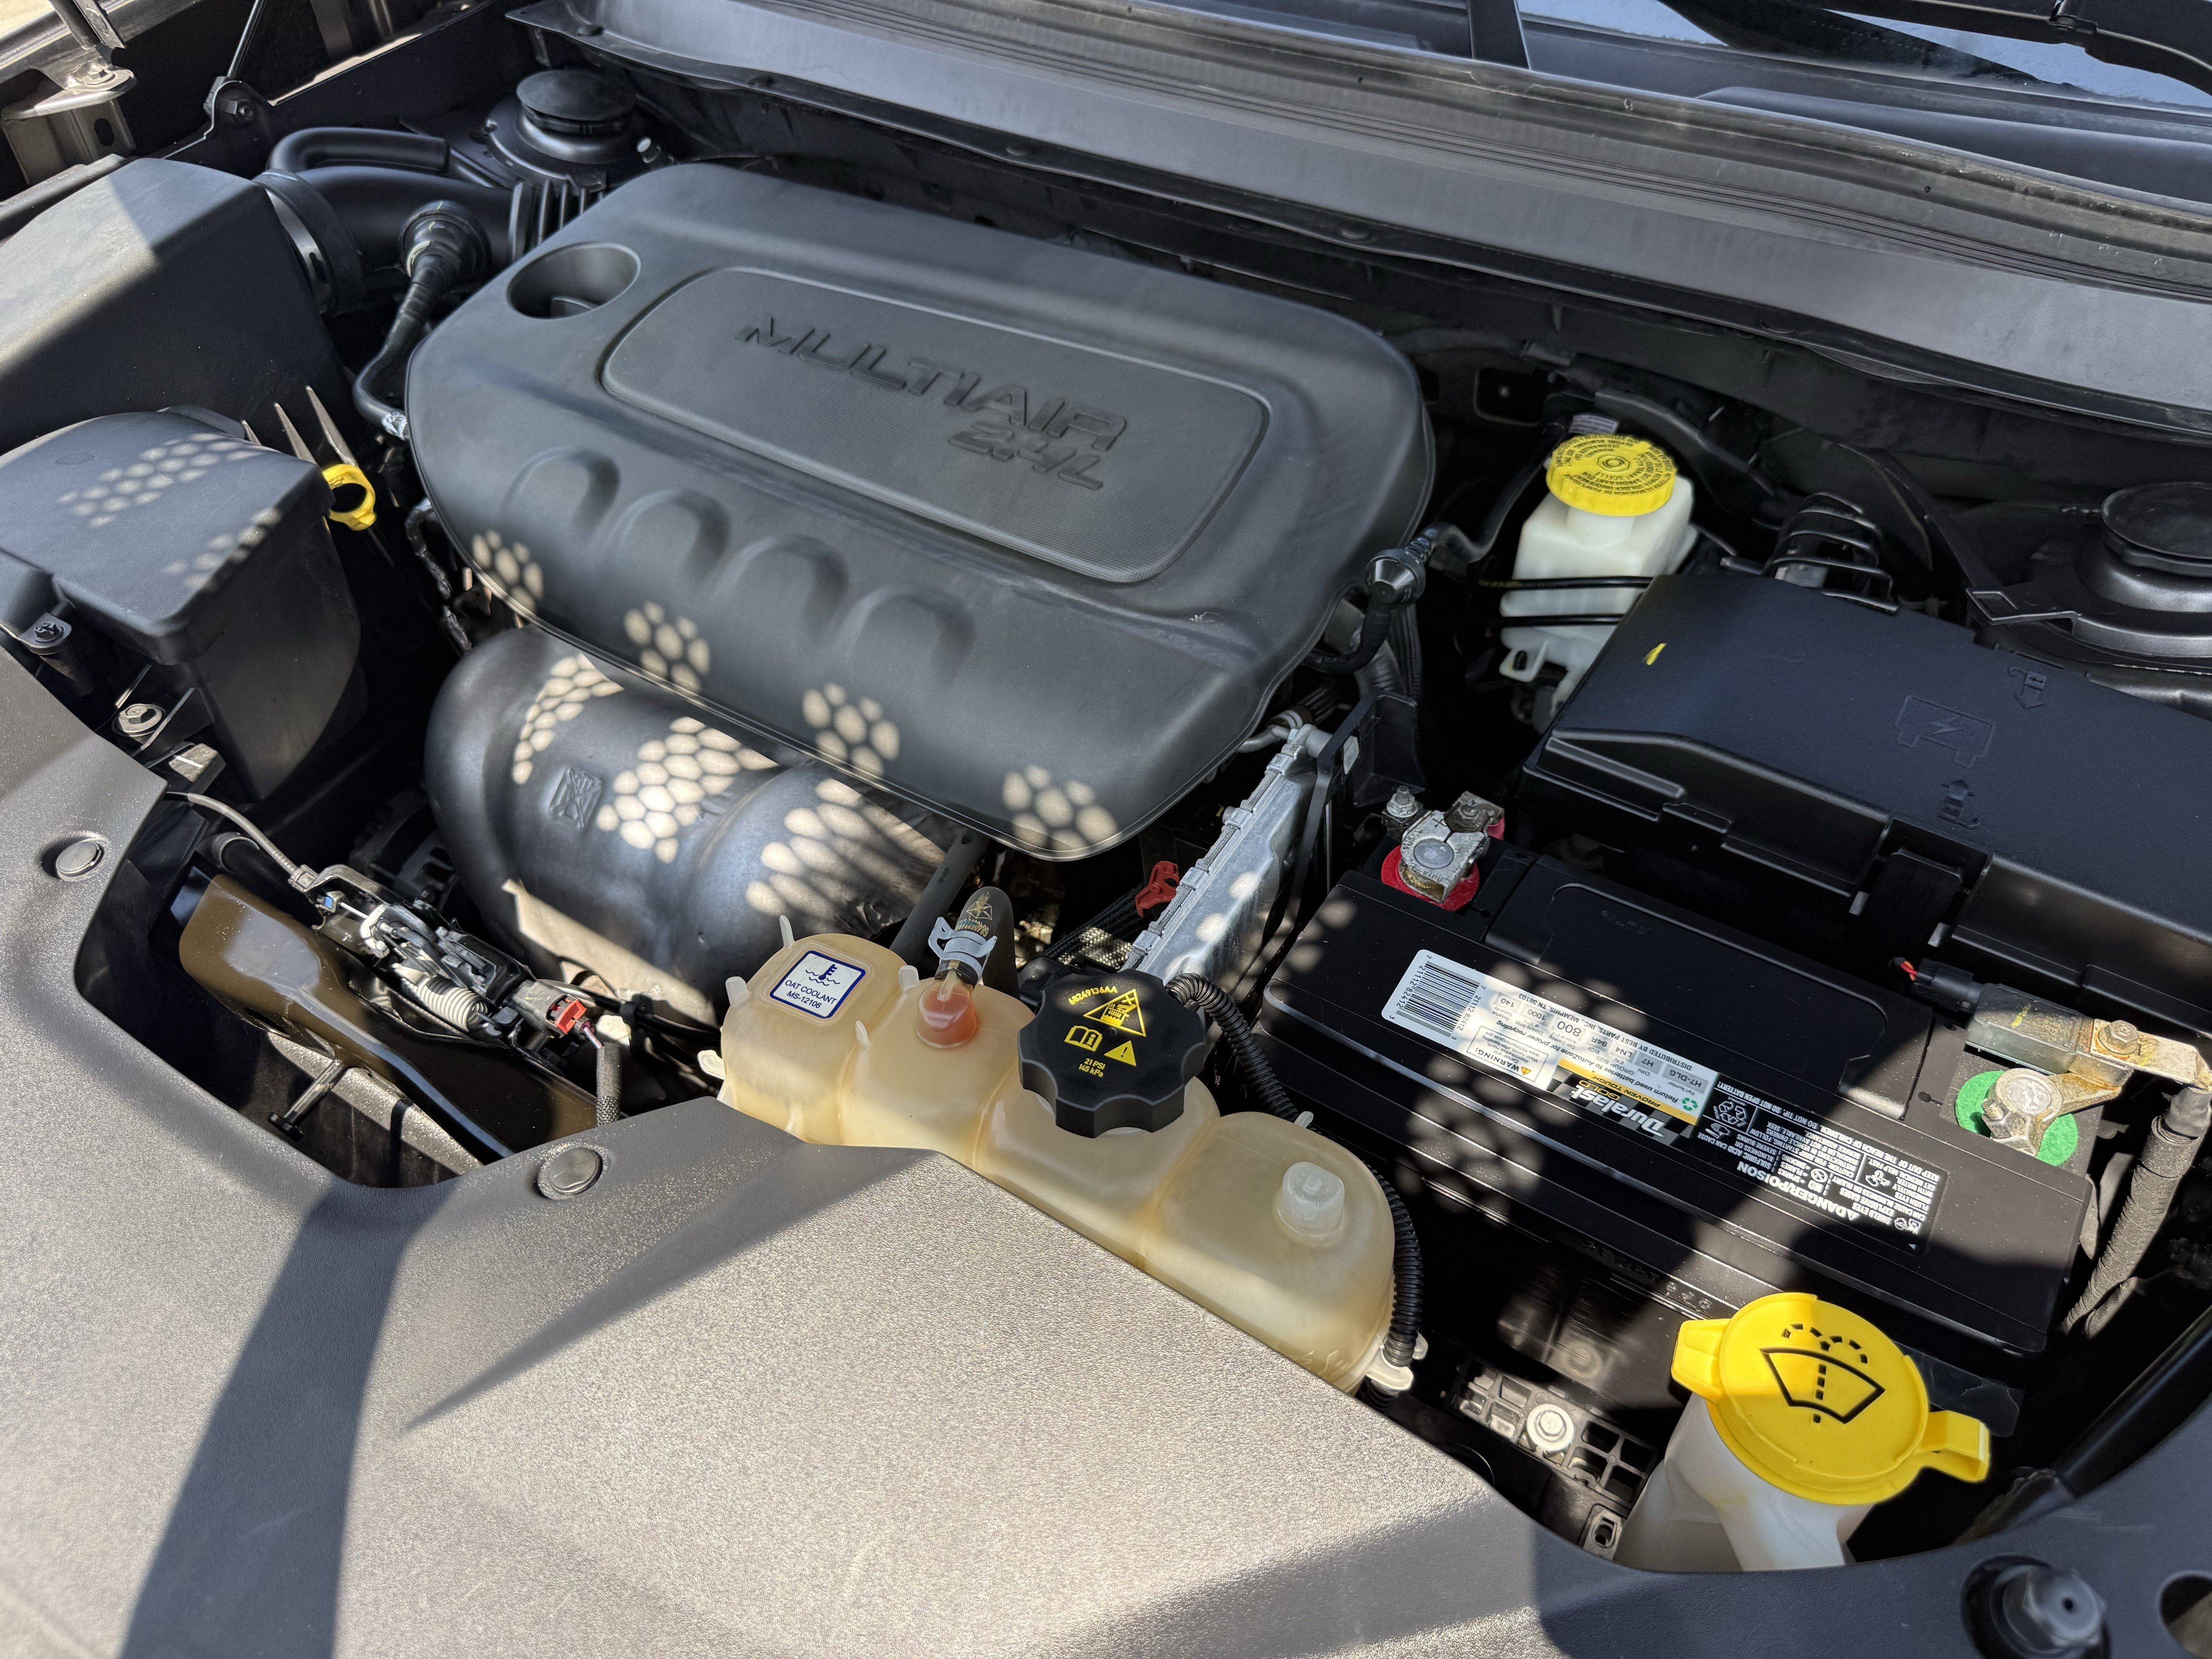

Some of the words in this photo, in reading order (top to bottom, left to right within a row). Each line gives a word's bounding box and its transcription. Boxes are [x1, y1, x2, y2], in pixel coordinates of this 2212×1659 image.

[735, 314, 1128, 452] MULTIAIR
[948, 421, 1104, 491] 2.4L
[1409, 965, 1426, 986] 21112
[785, 980, 801, 989] OAT
[800, 986, 837, 1004] COOLANT
[1068, 986, 1118, 1006] 68249136AA
[1395, 986, 1413, 1008] 82412
[1518, 993, 1538, 1005] 38103
[787, 991, 822, 1008] MS-12106
[1467, 994, 1481, 1013] 21112
[1500, 998, 1515, 1007] 140
[1491, 1010, 1510, 1021] Reserve
[1494, 1006, 1513, 1017] Capacity
[1527, 1009, 1546, 1020] 1000
[1547, 1005, 1580, 1022] MEMPHIS,
[1456, 1012, 1470, 1031] 82412
[1496, 1020, 1527, 1036] recycling
[1556, 1020, 1582, 1037] 800
[1580, 1019, 1596, 1029] INC.,
[1525, 1025, 1544, 1035] Cranking
[1596, 1025, 1620, 1040] PARTS,
[1481, 1035, 1501, 1046] handling
[1526, 1033, 1550, 1046] proper
[1548, 1034, 1566, 1045] Cranking
[1590, 1036, 1607, 1047] 94R
[1620, 1036, 1638, 1048] BEST
[1511, 1048, 1525, 1057] hands
[1549, 1043, 1560, 1051] for
[1615, 1046, 1632, 1058] LN4
[1638, 1044, 1648, 1052] BY
[1474, 1048, 1520, 1072] WARNING:
[1499, 1048, 1529, 1063] Reproductive
[1502, 1053, 1519, 1063] Cancer
[1525, 1054, 1538, 1062] Wash
[1559, 1048, 1595, 1066] AutoZone
[1595, 1055, 1609, 1064] SIZE
[1641, 1057, 1654, 1067] H7
[1648, 1048, 1692, 1071] DISTRIBUTED
[1079, 1064, 1091, 1072] 145
[1089, 1068, 1104, 1077] kPa
[1092, 1061, 1106, 1070] PSI
[1610, 1062, 1634, 1075] GROUP
[1637, 1068, 1650, 1076] DIN
[1602, 1066, 1634, 1085] batteries
[1668, 1069, 1702, 1087] H7-DLG
[1577, 1078, 1621, 1101] GOLD
[1591, 1075, 1623, 1091] TOUGH
[1634, 1080, 1653, 1092] used
[1667, 1080, 1685, 1091] Number
[1716, 1081, 1745, 1097] BATTERY!
[1623, 1089, 1661, 1108] PROVEN
[1653, 1089, 1678, 1103] Return
[1743, 1092, 1761, 1105] OPEN
[1568, 1083, 1665, 1139] Duralast
[1759, 1099, 1772, 1110] NOT
[1771, 1104, 1781, 1113] DO
[1781, 1109, 1795, 1119] TIP.
[1793, 1114, 1808, 1125] NOT
[1766, 1121, 1781, 1132] SEEK
[1807, 1120, 1818, 1129] DO
[1697, 1131, 1716, 1145] CAUSE
[1736, 1133, 1755, 1146] BURNS
[1749, 1128, 1772, 1142] FOLLOW
[1765, 1127, 1789, 1142] OWNERS
[1779, 1127, 1811, 1145] AVAILABLE,
[1803, 1130, 1838, 1150] ASSISTANCE.
[1817, 1124, 1853, 1144] CHILDREN.
[1715, 1139, 1728, 1150] CAN
[1726, 1144, 1743, 1157] ACID
[1734, 1140, 1744, 1149] OR
[1755, 1142, 1777, 1156] SEVERE
[1787, 1137, 1811, 1152] VEHICLE
[1809, 1140, 1822, 1150] NOT
[1851, 1139, 1863, 1149] OF
[1861, 1143, 1885, 1158] REACH
[1743, 1144, 1775, 1163] BLINDNESS
[1798, 1149, 1815, 1161] JUMP
[1826, 1147, 1836, 1156] OR
[1834, 1151, 1859, 1166] MANUAL
[1836, 1144, 1861, 1159] SERVICE
[1882, 1152, 1898, 1164] THE
[1742, 1151, 1772, 1170] SULFURIC
[1781, 1153, 1807, 1170] SMOKING
[1814, 1156, 1827, 1166] FOR
[1816, 1150, 1856, 1172] INSTRUCTIONS
[1866, 1157, 1884, 1169] FAST.
[1896, 1158, 1908, 1168] OF
[1777, 1167, 1801, 1183] SPARKS
[1779, 1161, 1804, 1176] FLAMES
[1826, 1161, 1854, 1178] CAUTION:
[1882, 1164, 1899, 1176] HELP
[1906, 1163, 1922, 1175] OUT
[1921, 1169, 1939, 1182] KEEP
[1831, 1175, 1854, 1190] INJURY
[1894, 1176, 1917, 1191] WATER.
[1898, 1171, 1924, 1186] MEDICAL
[1736, 1160, 1848, 1218] DANGER/POISON
[1807, 1178, 1823, 1194] NO
[1852, 1184, 1862, 1193] OR
[1917, 1186, 1934, 1198] WITH
[1922, 1181, 1936, 1192] GET
[1838, 1186, 1860, 1202] GASES
[1861, 1188, 1894, 1208] BLINDNESS
[1891, 1182, 1931, 1205] IMMEDIATELY
[1893, 1191, 1910, 1203] EYES
[1851, 1201, 1870, 1216] EYES
[1859, 1195, 1894, 1218] EXPLOSIVE
[1893, 1202, 1913, 1216] CAUSE
[1908, 1197, 1929, 1212] FLUSH
[1868, 1209, 1891, 1226] SHIELD
[1912, 1210, 1926, 1222] CAN
